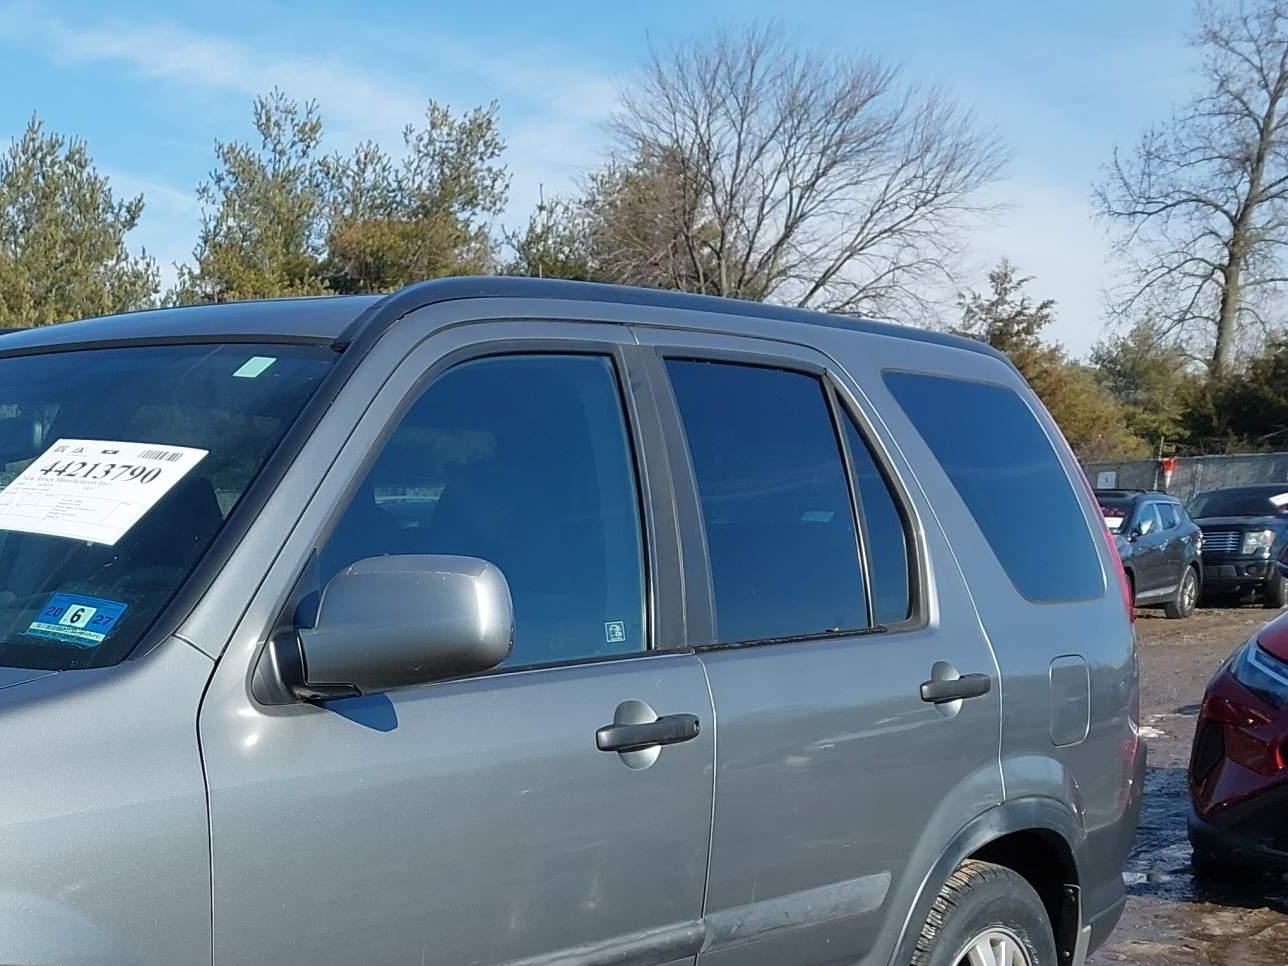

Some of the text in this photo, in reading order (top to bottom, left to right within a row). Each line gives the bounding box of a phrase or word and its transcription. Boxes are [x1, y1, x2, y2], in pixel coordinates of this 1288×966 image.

[40, 460, 162, 485] 44213790
[44, 606, 114, 626] 20 6 27
